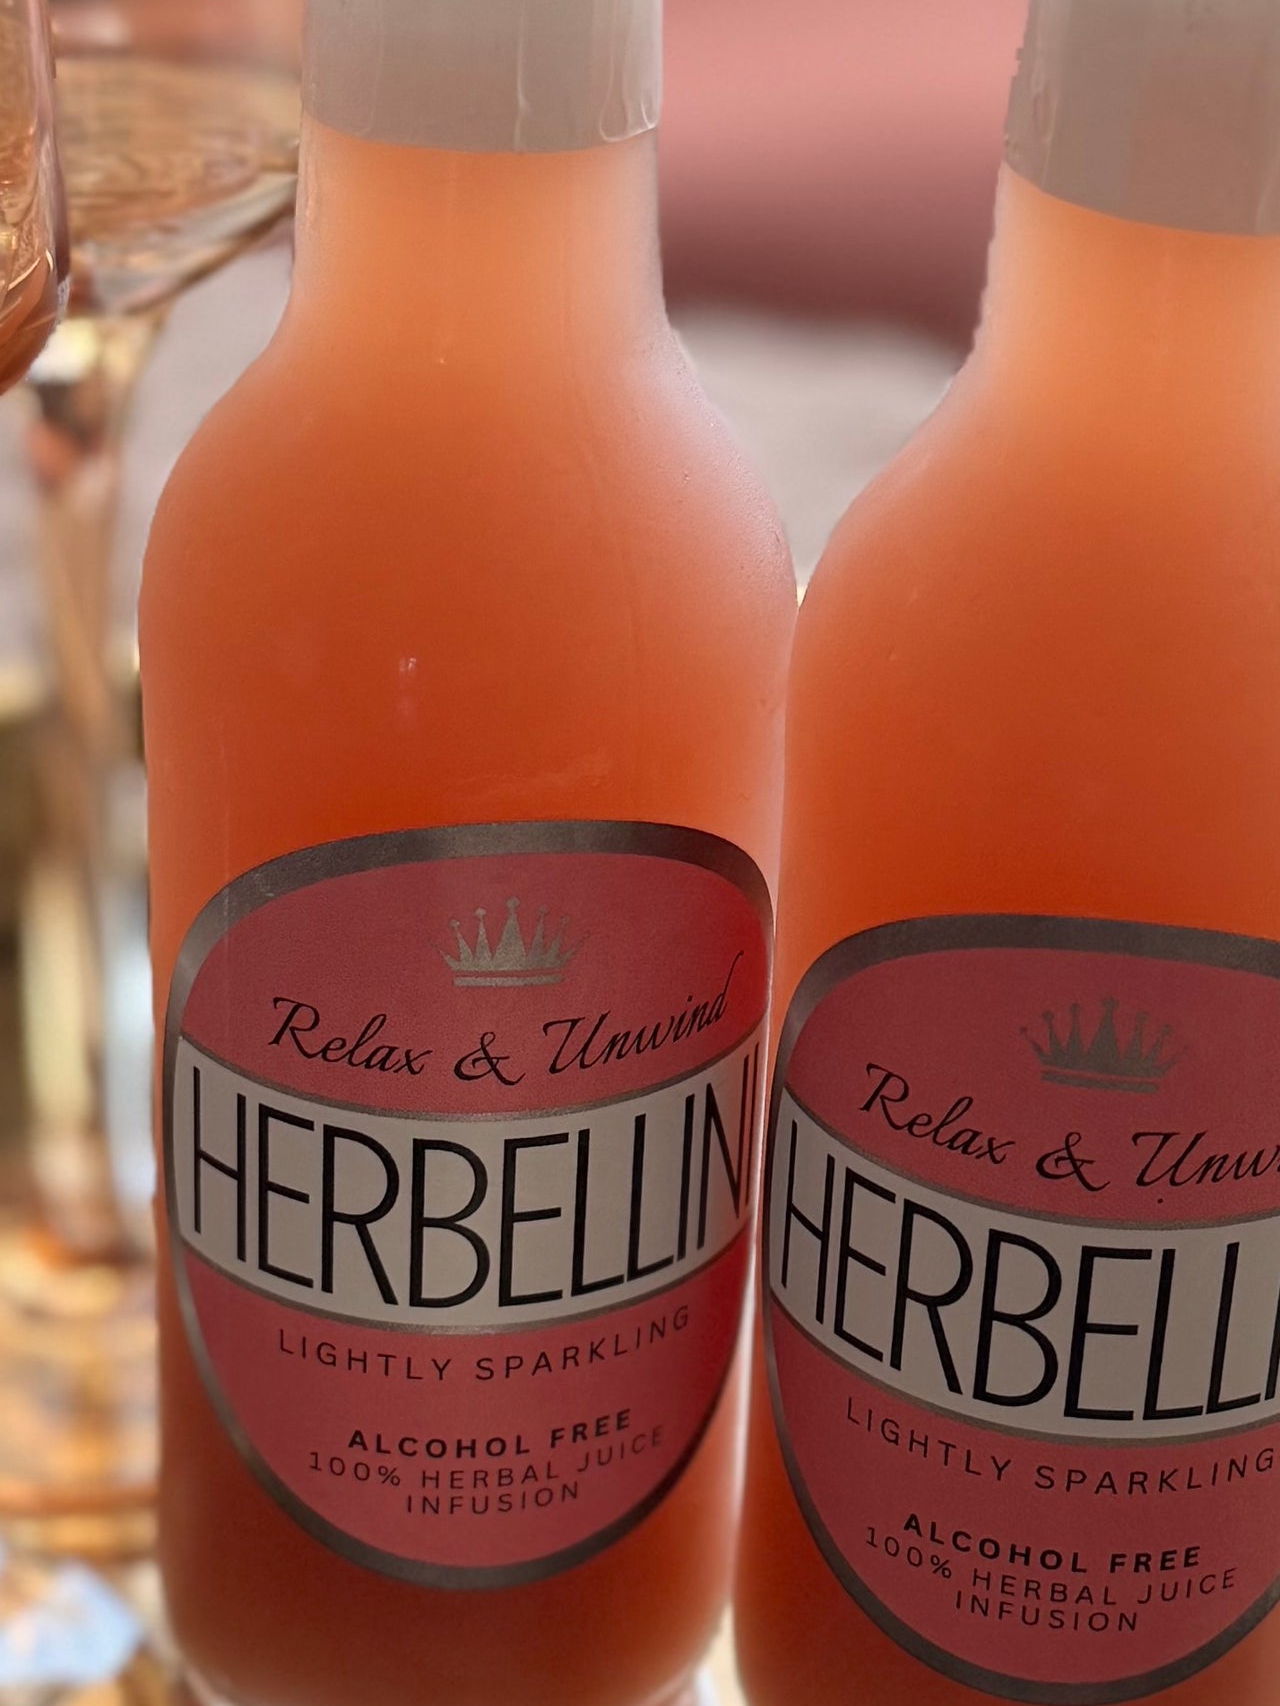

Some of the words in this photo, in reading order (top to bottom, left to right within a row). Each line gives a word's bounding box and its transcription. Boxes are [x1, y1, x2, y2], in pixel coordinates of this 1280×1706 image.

[267, 996, 432, 1076] Relax
[452, 1030, 526, 1087] &
[542, 949, 745, 1074] Unwind
[858, 1061, 1016, 1166] Relax
[1034, 1130, 1112, 1193] &
[191, 1040, 761, 1310] HERBELLINI
[278, 1327, 452, 1382] LIGHTLY
[474, 1304, 691, 1381] SPARKLING
[307, 1450, 403, 1487] 100%
[421, 1460, 560, 1490] HERBAL
[576, 1423, 666, 1474] JUICE
[347, 1428, 532, 1459] ALCOHOL
[549, 1407, 632, 1449] FREE
[846, 1395, 1012, 1482] LIGHTLY
[1033, 1447, 1276, 1496] SPARKLING
[406, 1480, 580, 1516] INFUSION
[864, 1525, 954, 1580] 100%
[971, 1567, 1118, 1606] HERBAL
[1136, 1566, 1238, 1606] JUICE
[902, 1512, 1089, 1574] ALCOHOL
[1108, 1545, 1202, 1574] FREE
[954, 1589, 1139, 1632] INFUSION
